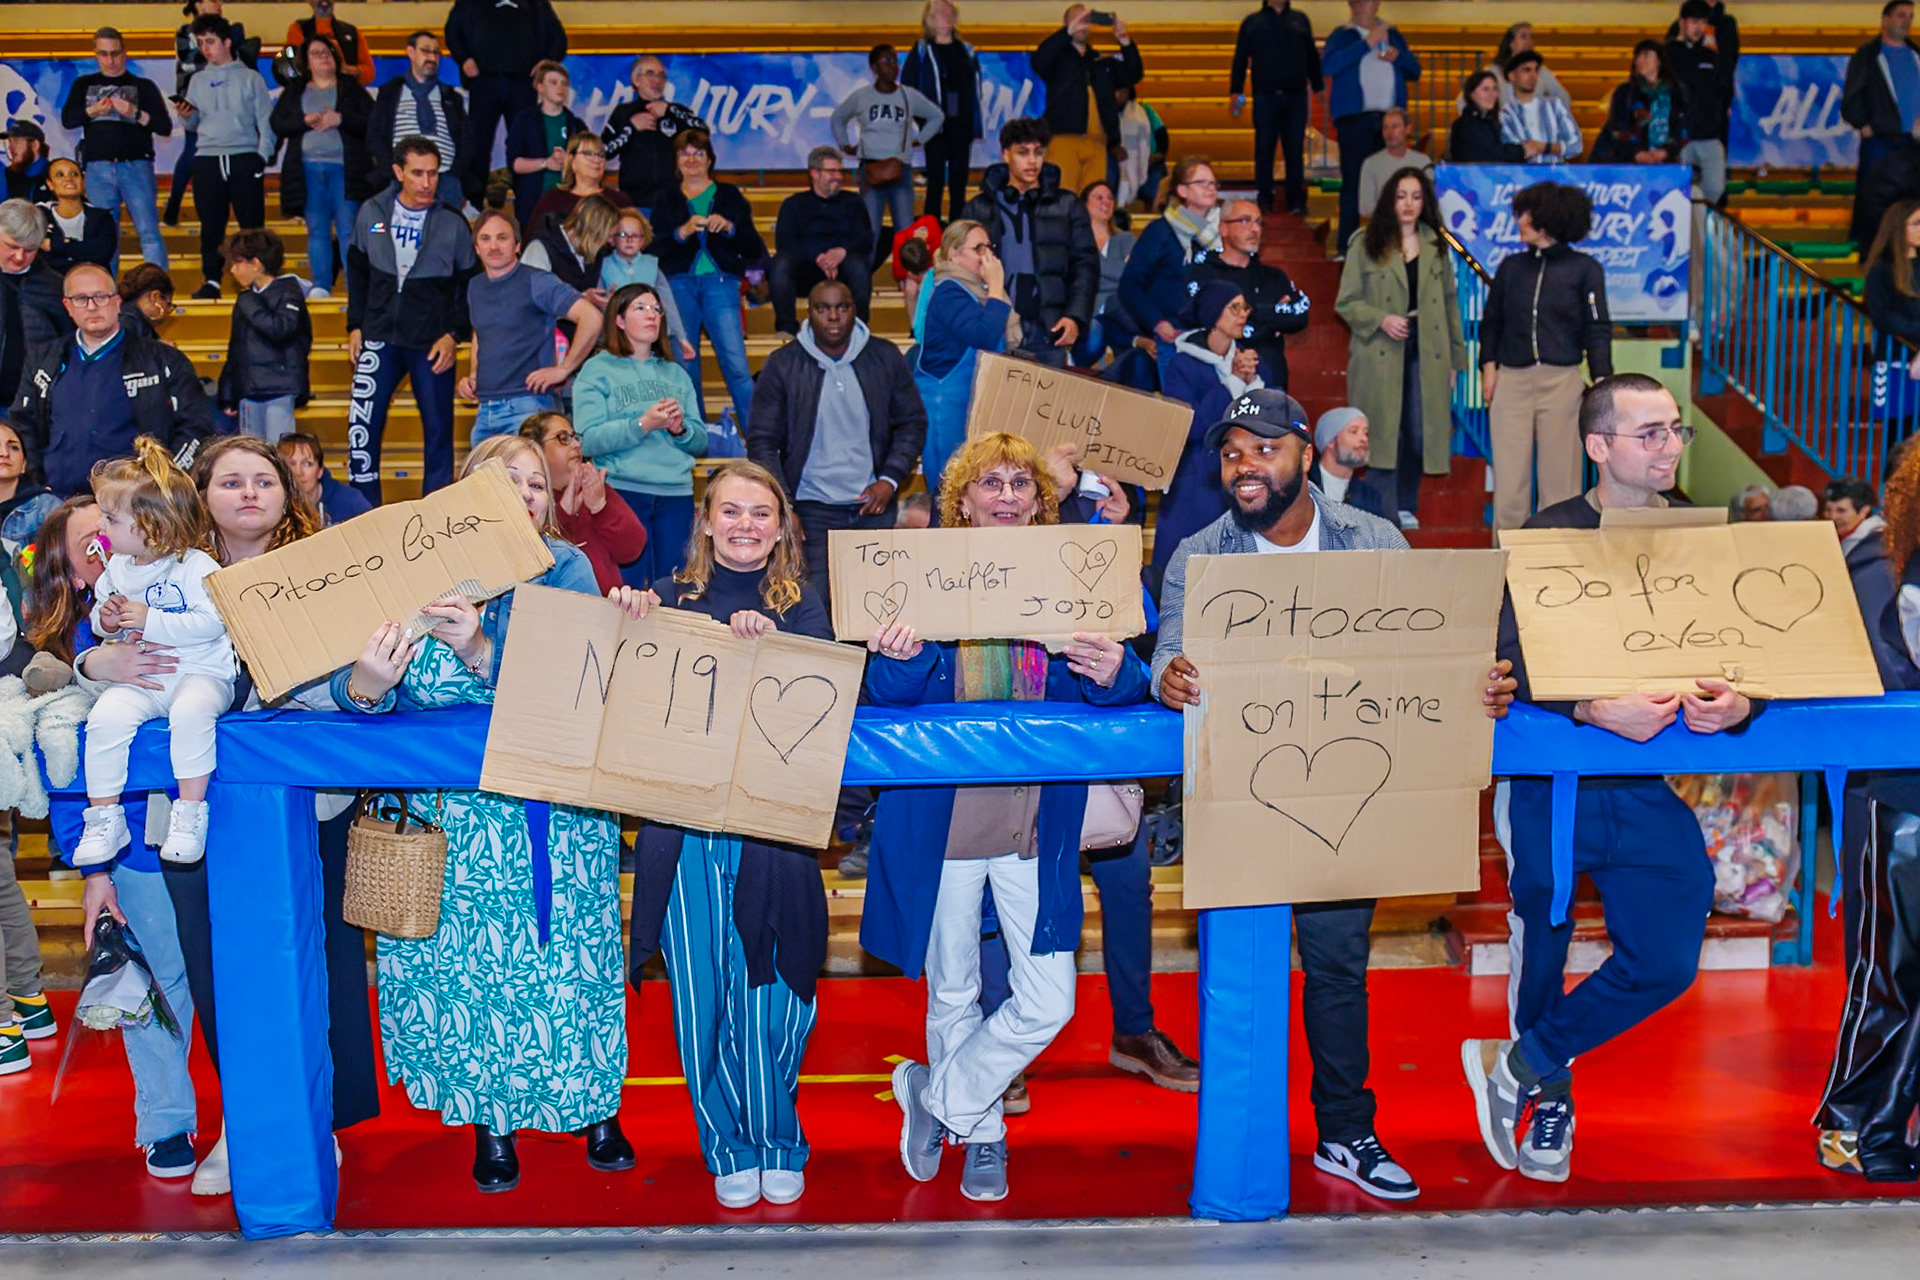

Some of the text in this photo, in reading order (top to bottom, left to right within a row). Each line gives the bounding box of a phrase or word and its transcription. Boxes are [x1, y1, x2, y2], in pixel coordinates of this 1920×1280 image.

[869, 103, 905, 122] GAP
[1758, 82, 1856, 140] ALL
[395, 225, 421, 249] 44
[1006, 369, 1054, 390] FAN
[1037, 403, 1102, 436] CLUB
[1083, 442, 1164, 478] PITOCCO
[855, 542, 911, 566] Tom
[240, 554, 384, 612] Pitocco
[1527, 564, 1612, 608] Jo
[1202, 586, 1445, 640] Pitocco
[1241, 676, 1443, 735] on t'aime
